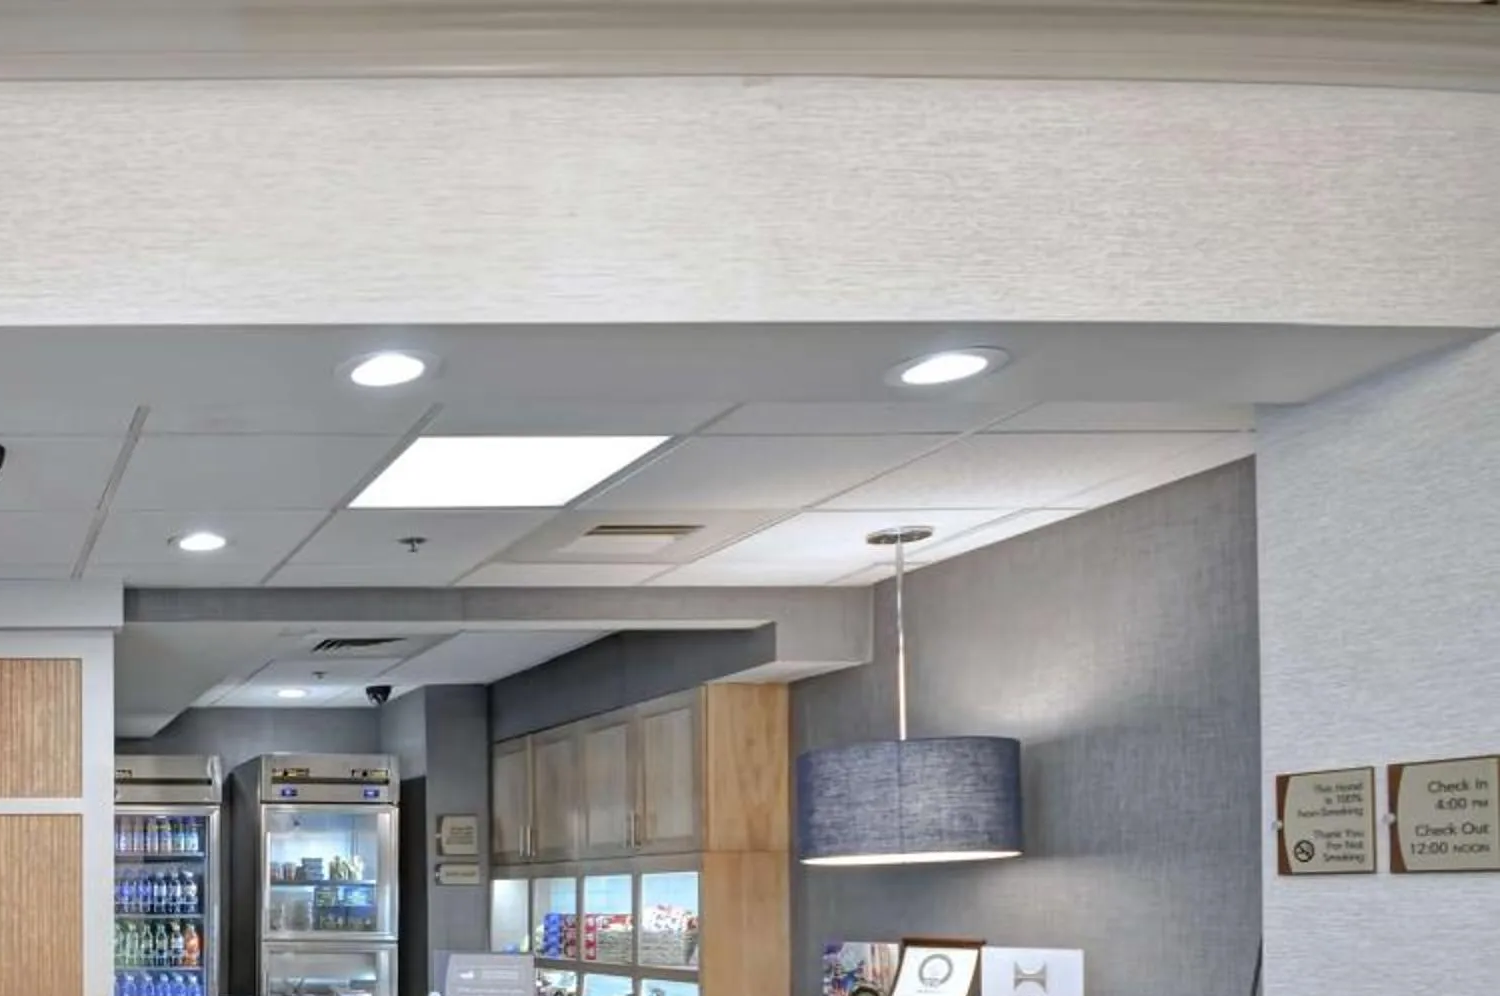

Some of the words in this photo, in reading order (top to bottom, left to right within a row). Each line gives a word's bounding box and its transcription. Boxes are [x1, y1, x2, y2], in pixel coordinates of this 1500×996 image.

[1428, 777, 1469, 794] Check
[1436, 797, 1468, 811] 4:00
[1415, 821, 1457, 838] Check
[1462, 820, 1491, 835] Out
[1411, 841, 1449, 856] 12:00
